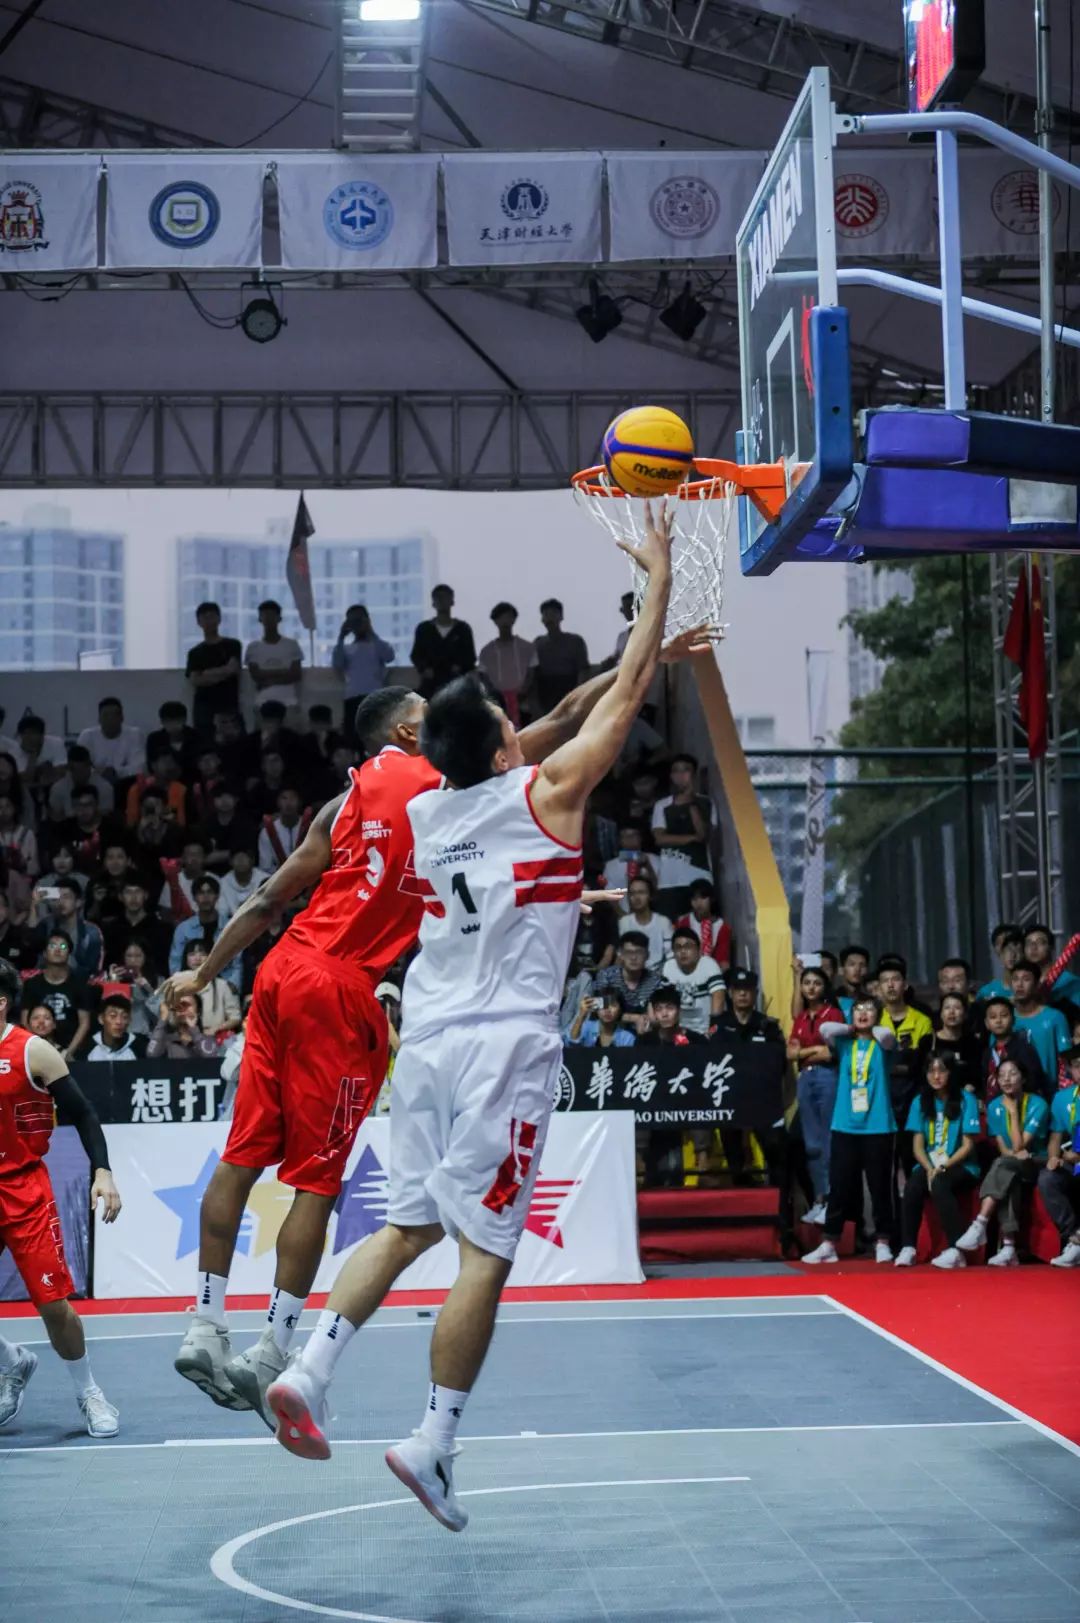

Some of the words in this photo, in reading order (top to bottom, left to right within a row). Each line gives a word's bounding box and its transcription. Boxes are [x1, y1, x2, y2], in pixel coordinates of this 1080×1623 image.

[748, 140, 803, 312] XIAMEN
[633, 463, 684, 481] molten
[452, 872, 478, 914] 1
[131, 1077, 222, 1122] 想打
[655, 1109, 736, 1123] UNIVERSITY
